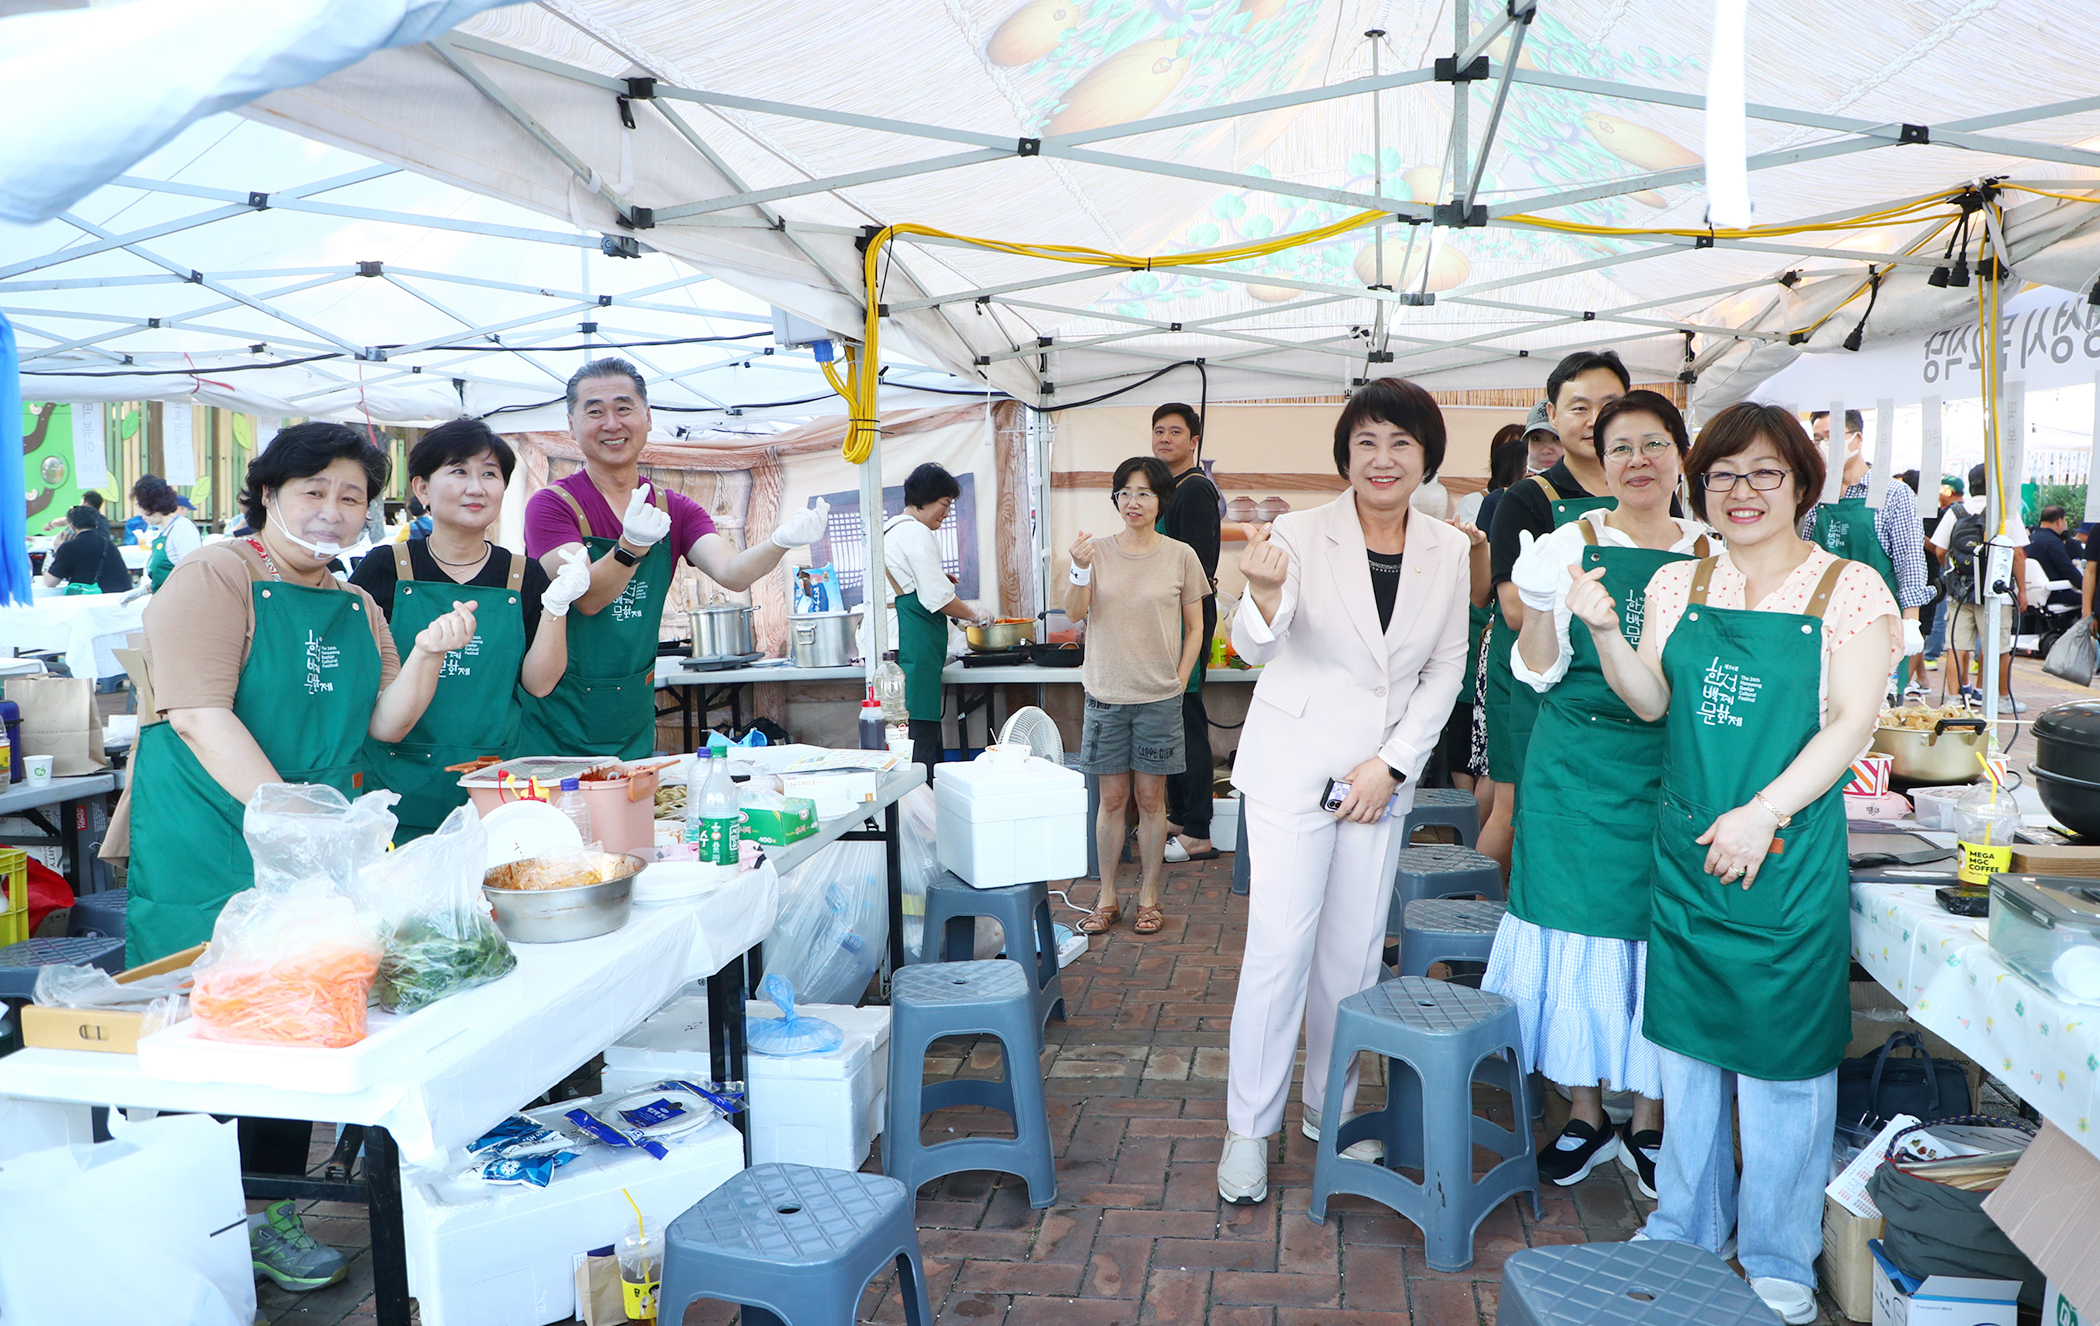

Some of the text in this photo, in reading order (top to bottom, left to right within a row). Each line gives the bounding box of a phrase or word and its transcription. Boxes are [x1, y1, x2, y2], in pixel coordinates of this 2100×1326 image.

[1704, 656, 1738, 692] 한성
[1703, 685, 1734, 705] 백제
[1696, 701, 1743, 727] 문화제
[790, 779, 817, 787] NITRILE
[48, 846, 56, 869] ARTY
[1969, 851, 1995, 859] MEGA
[1969, 864, 1999, 873] COFFEE
